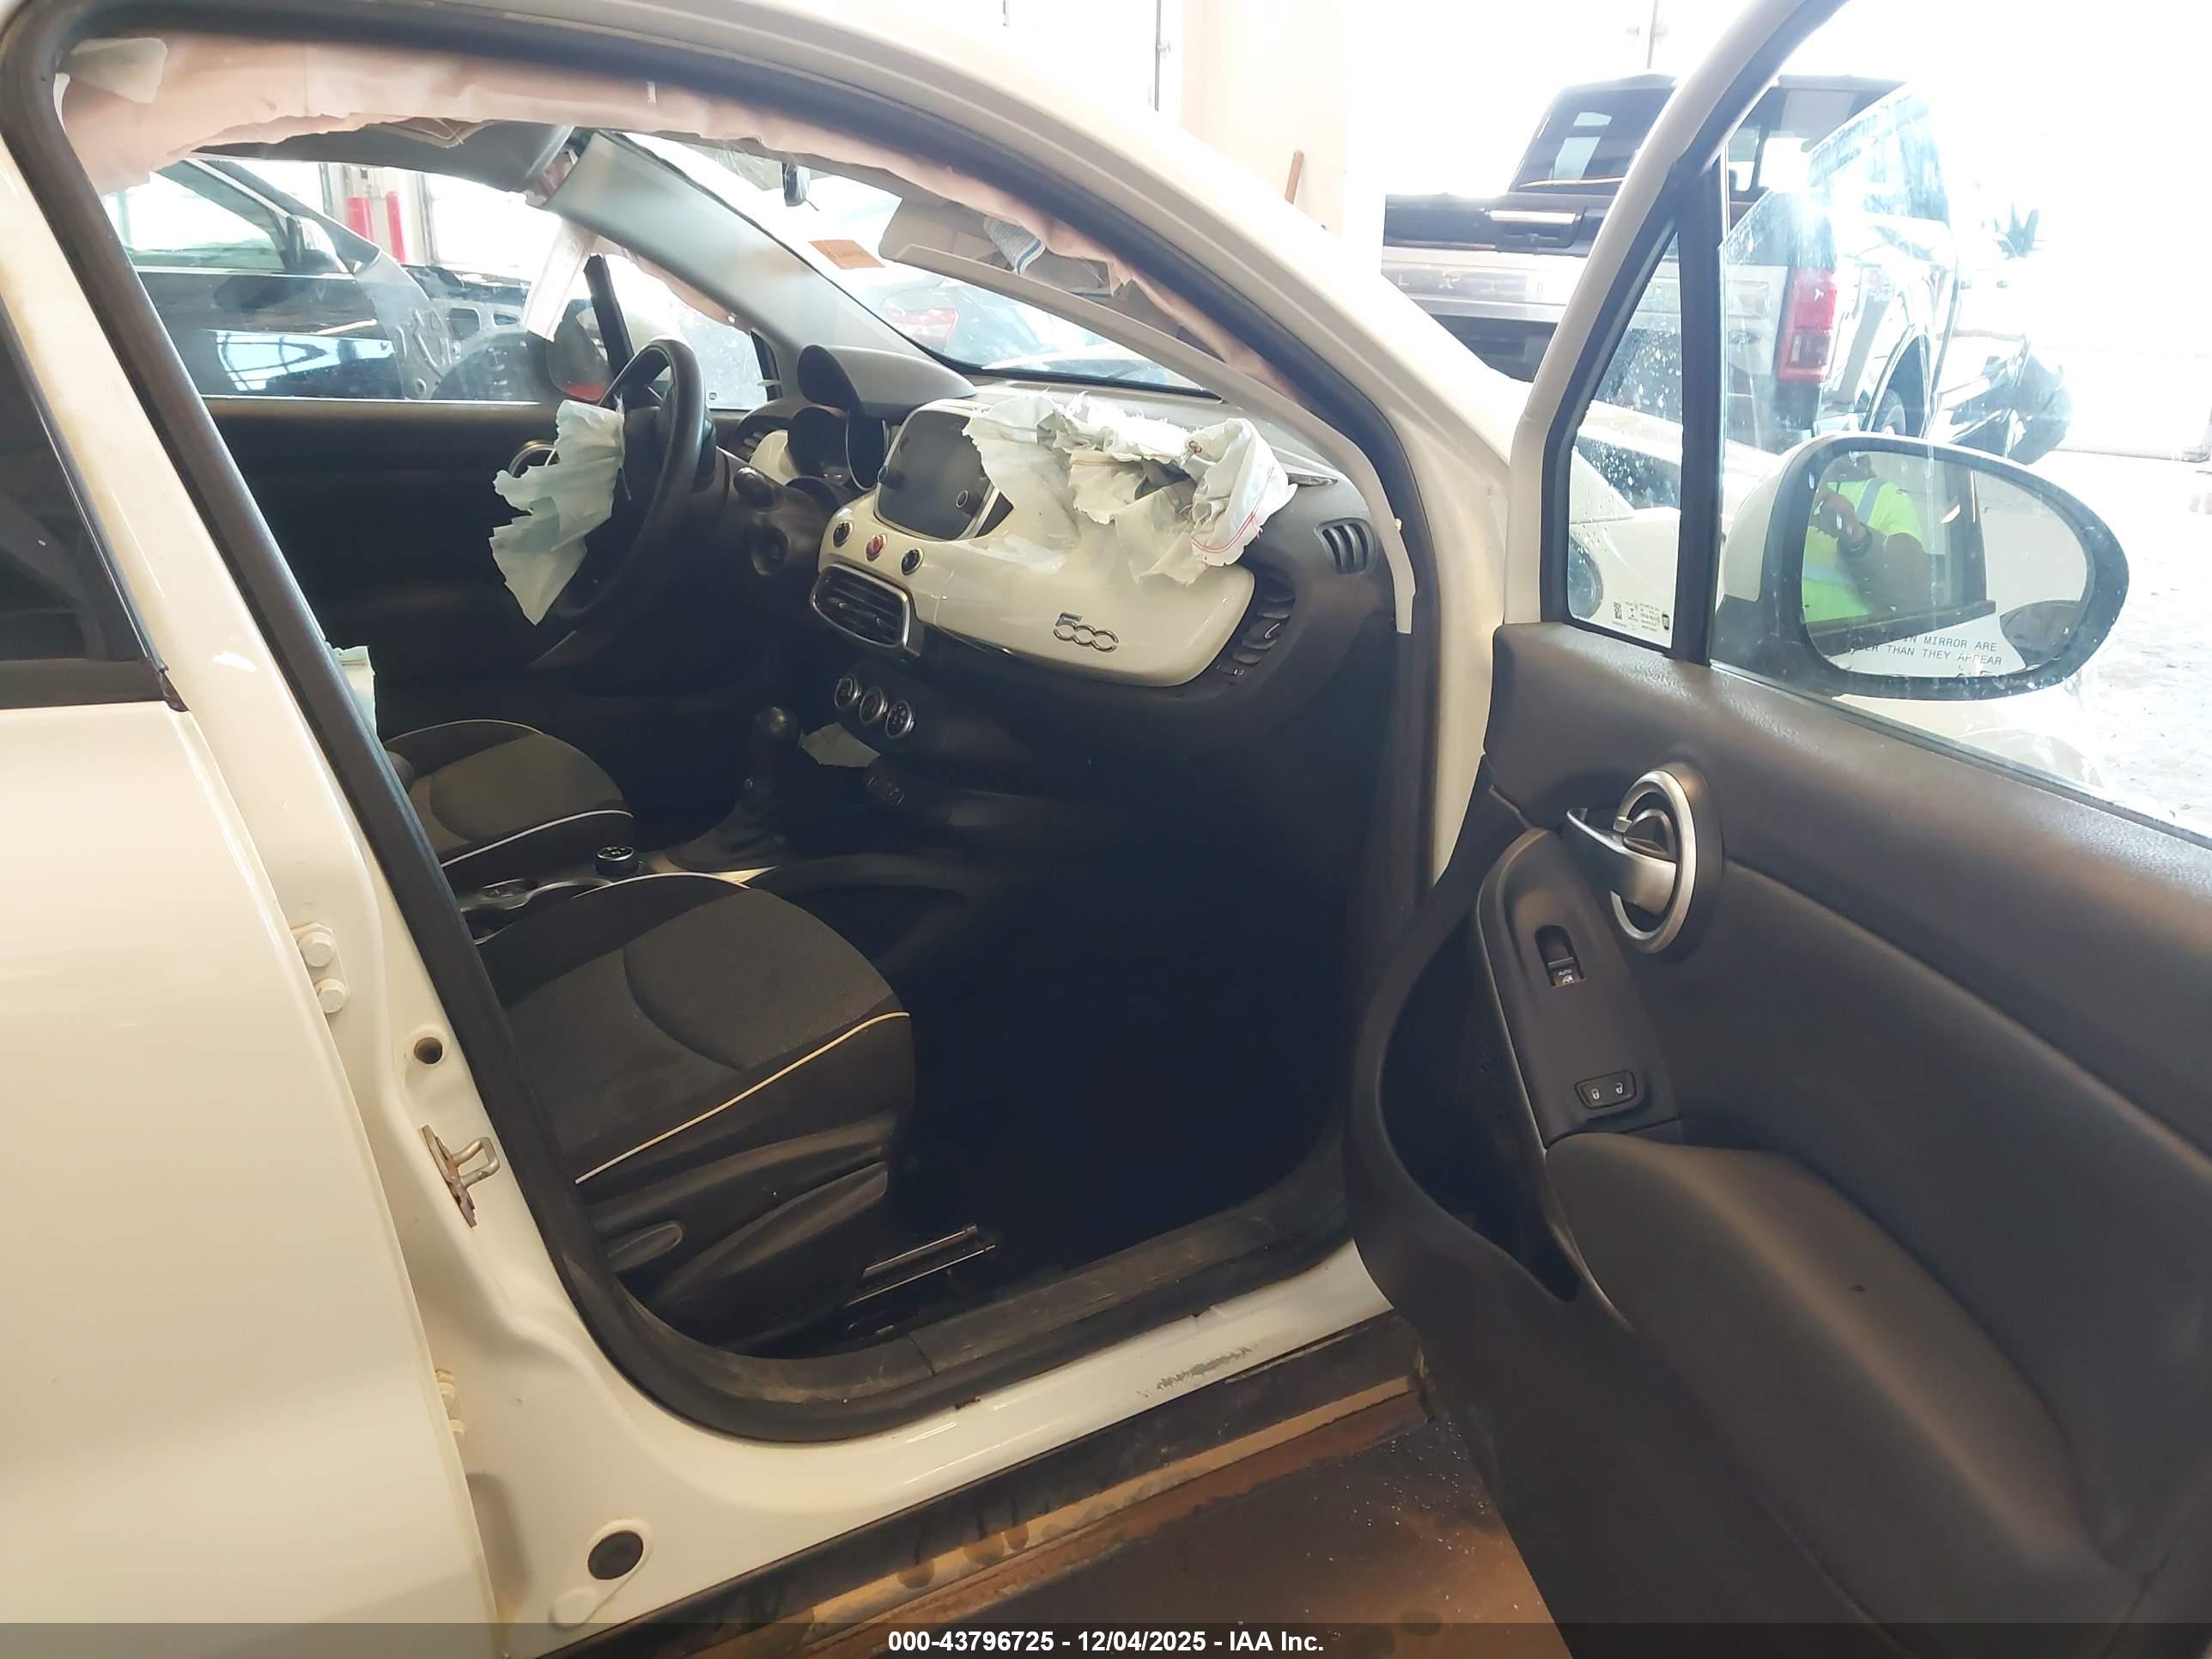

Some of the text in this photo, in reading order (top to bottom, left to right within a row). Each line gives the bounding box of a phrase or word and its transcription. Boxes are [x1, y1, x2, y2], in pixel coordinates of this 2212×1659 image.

[1053, 612, 1120, 653] 500
[1887, 644, 1915, 656] THAN
[1923, 648, 1952, 660] THEY
[1956, 652, 2002, 666] APPEAR
[1923, 635, 1968, 649] MIRROR
[1974, 641, 1998, 653] ARE
